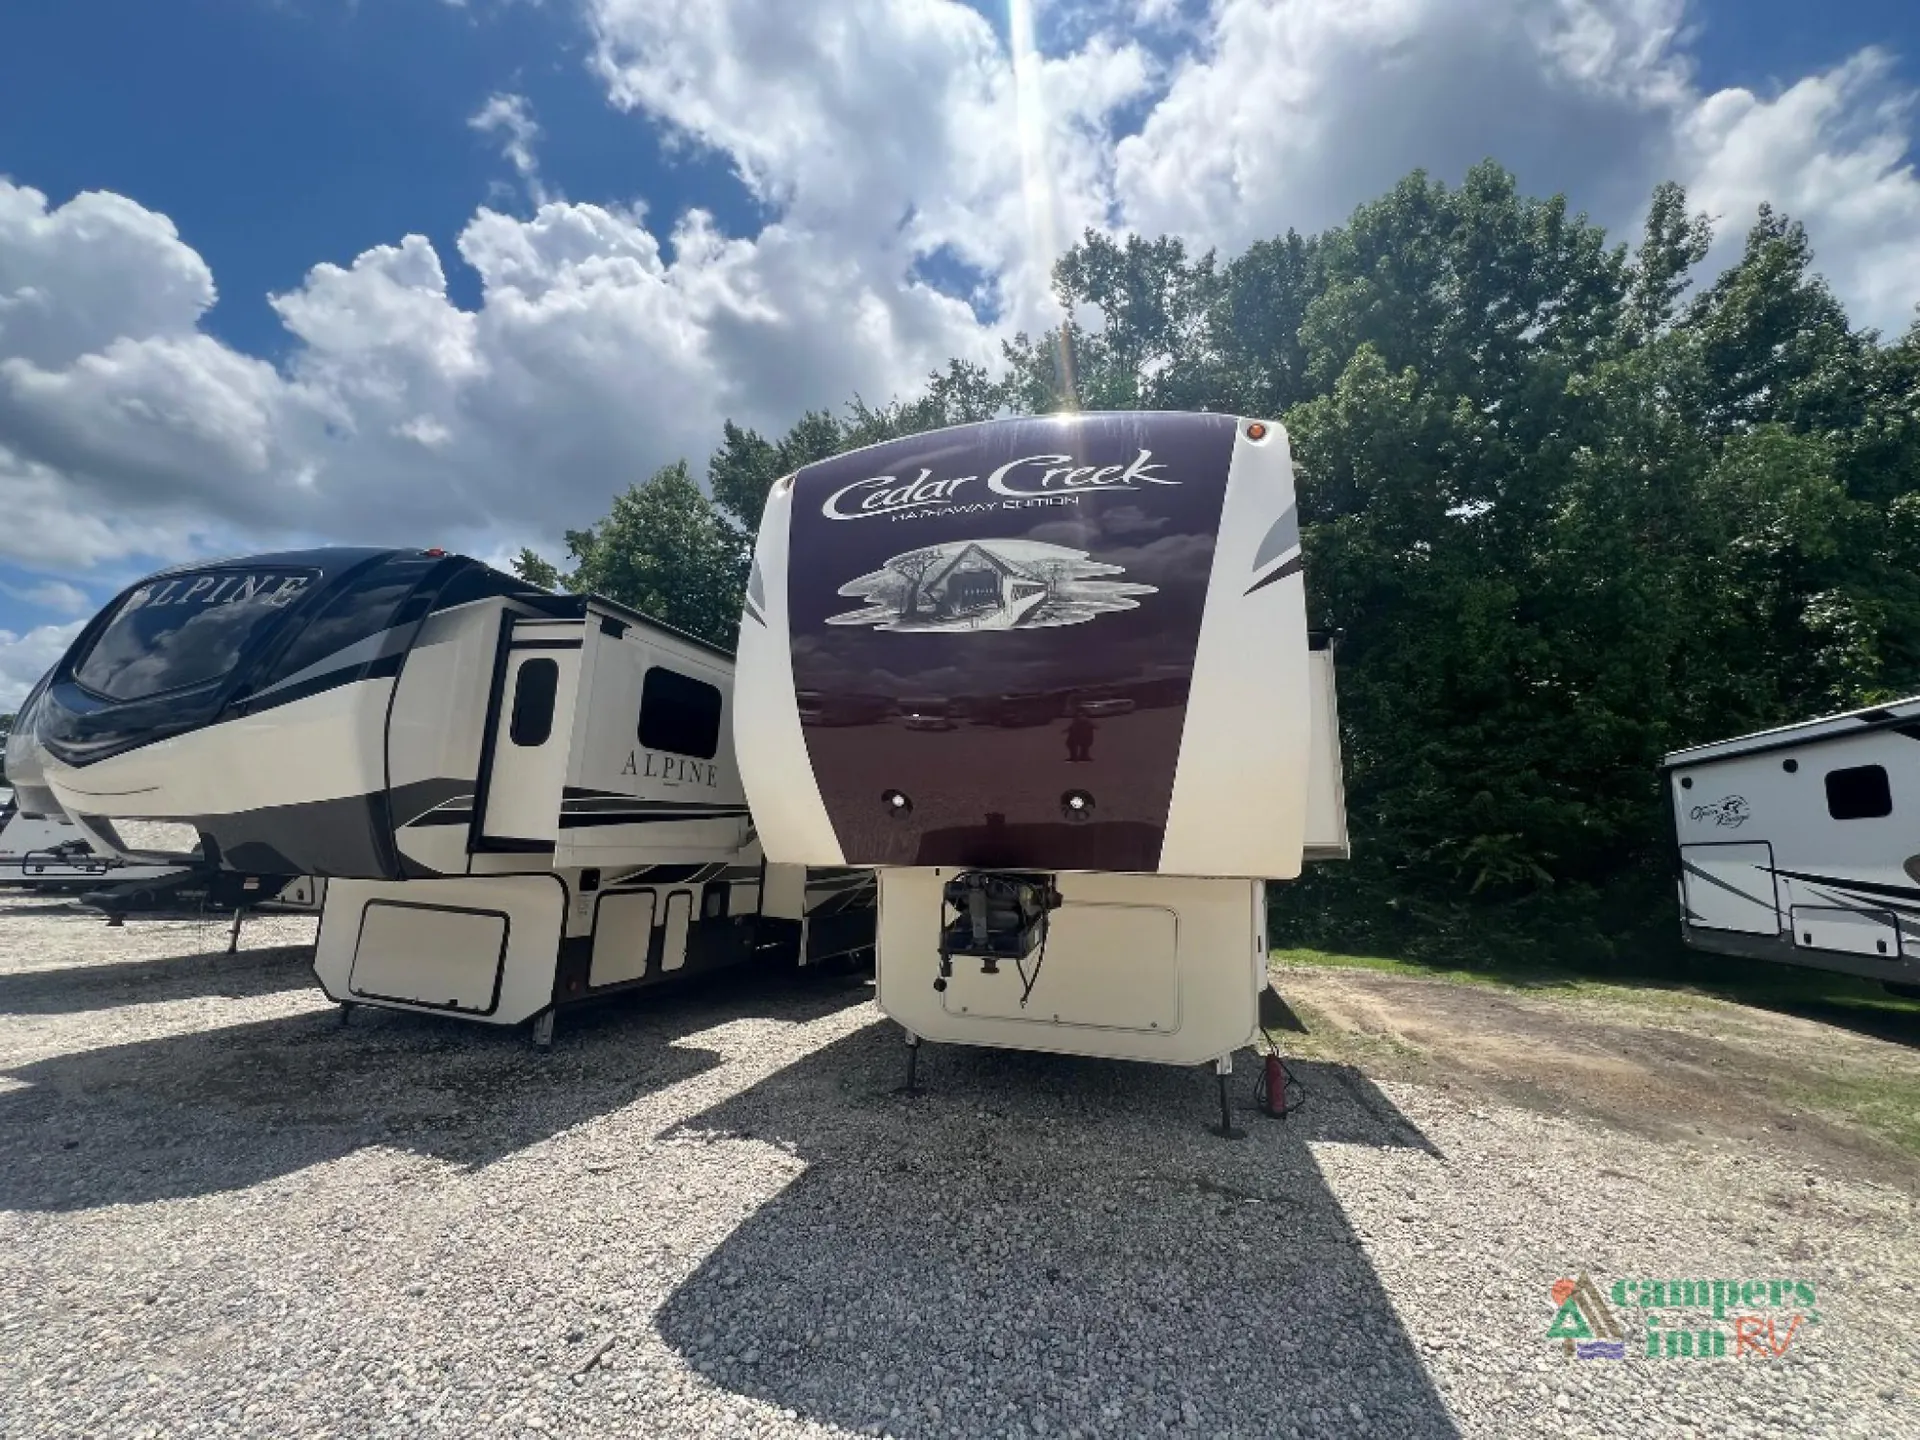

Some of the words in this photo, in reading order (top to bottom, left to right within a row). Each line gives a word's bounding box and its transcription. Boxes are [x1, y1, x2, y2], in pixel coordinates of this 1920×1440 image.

[821, 468, 978, 521] Cedar
[987, 449, 1182, 497] Creek
[891, 501, 998, 522] HATHAWAY
[1002, 496, 1079, 510] EDITION
[621, 749, 718, 788] ALPINE
